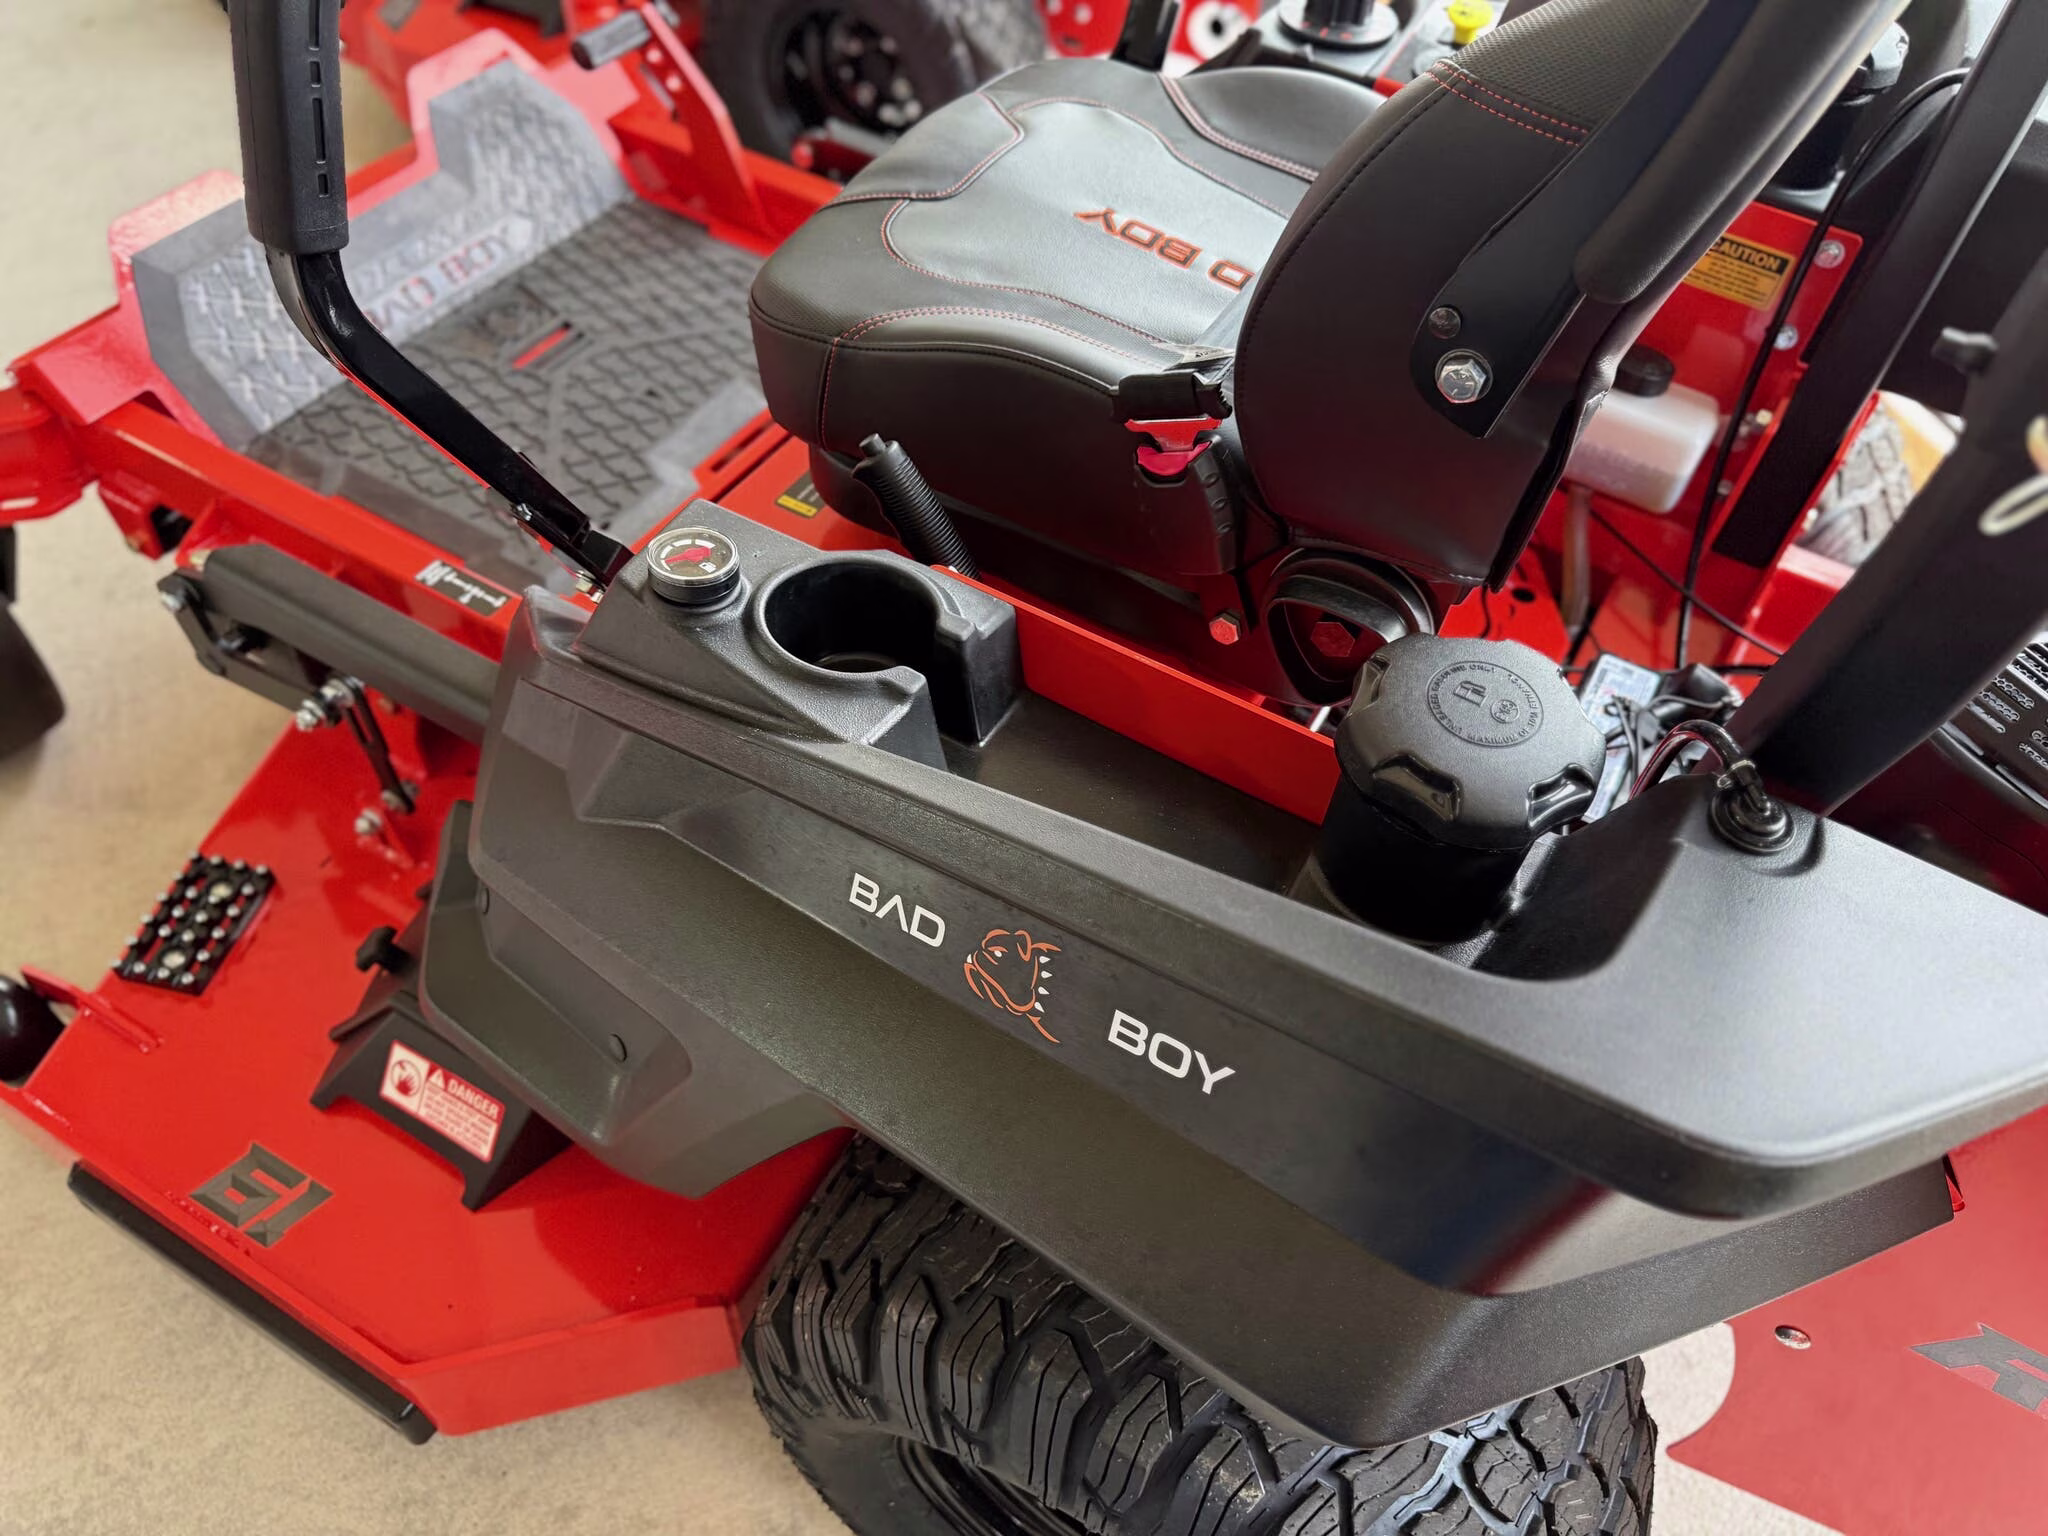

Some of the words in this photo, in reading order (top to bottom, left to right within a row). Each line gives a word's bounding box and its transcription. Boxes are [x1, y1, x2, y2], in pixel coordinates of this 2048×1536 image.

[1074, 208, 1203, 269] BOY
[849, 872, 946, 948] BAD
[1107, 1009, 1236, 1095] BOY
[447, 1078, 500, 1119] DANGER
